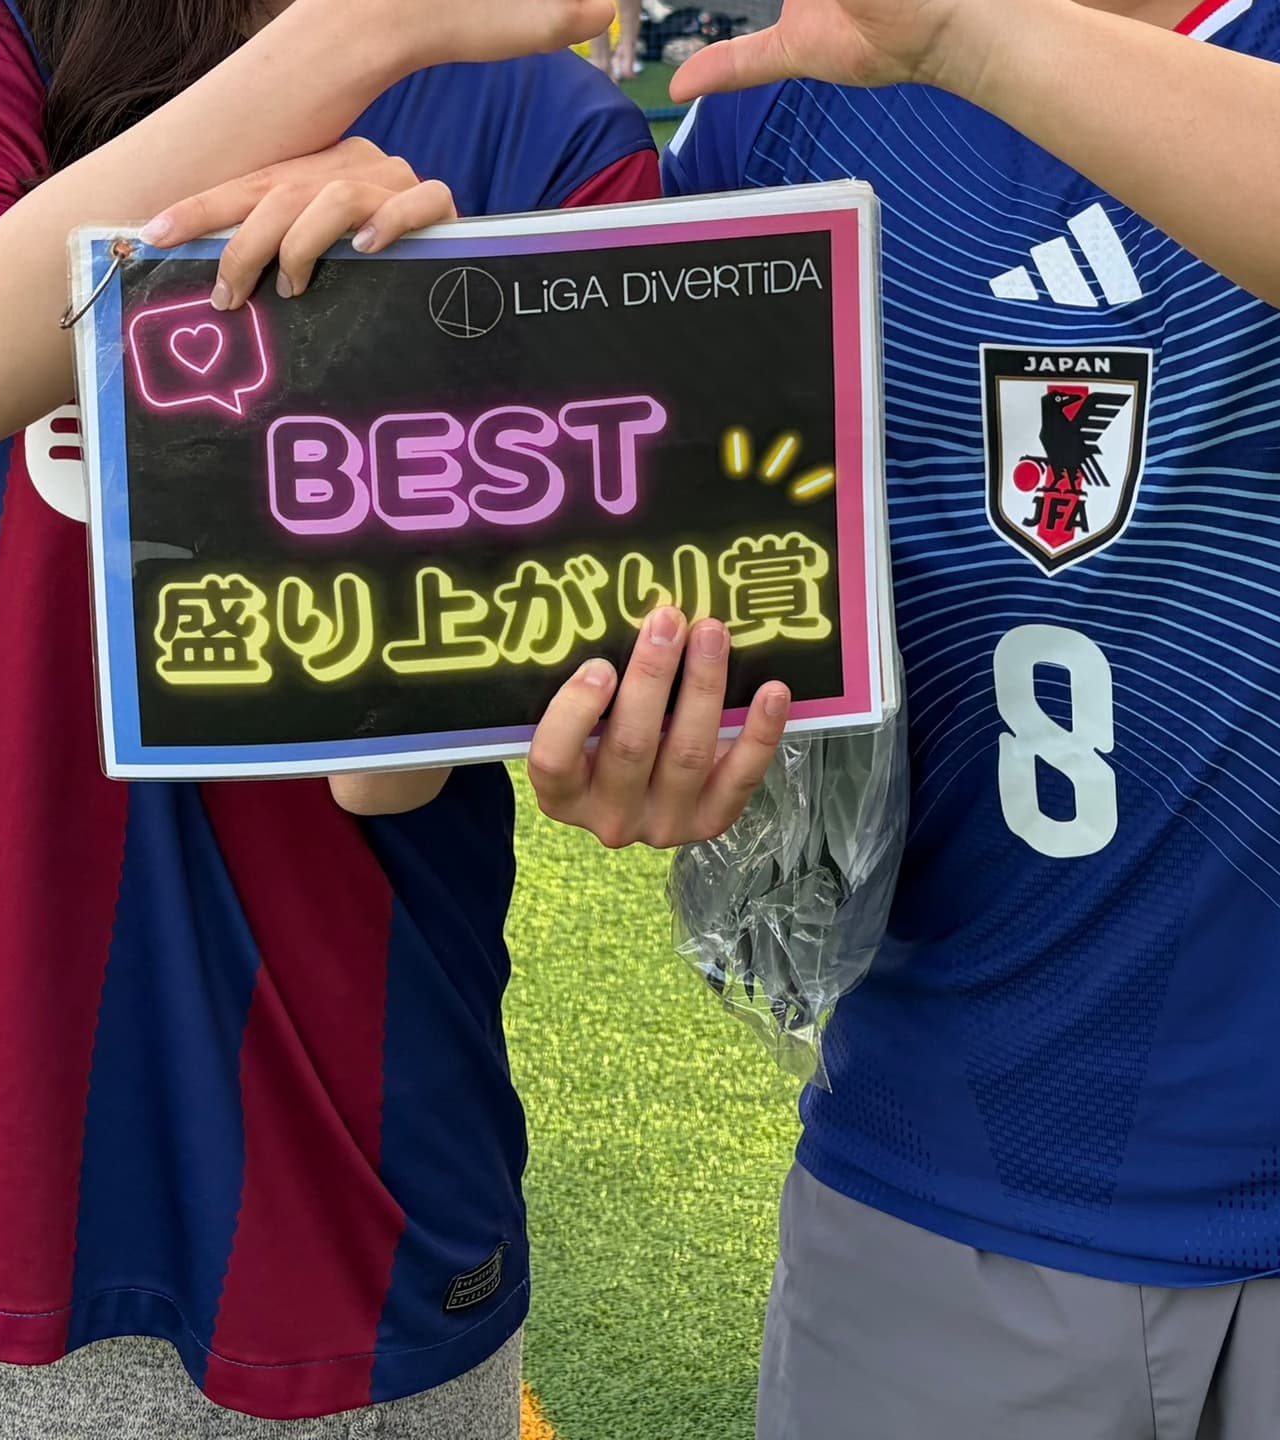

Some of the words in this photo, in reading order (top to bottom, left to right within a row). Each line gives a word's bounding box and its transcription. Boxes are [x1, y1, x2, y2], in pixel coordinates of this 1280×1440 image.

[1023, 356, 1111, 373] JAPAN
[268, 395, 668, 534] BEST
[1022, 496, 1089, 533] JFA
[156, 532, 831, 685] 盛り上がり賞
[993, 624, 1117, 857] 8
